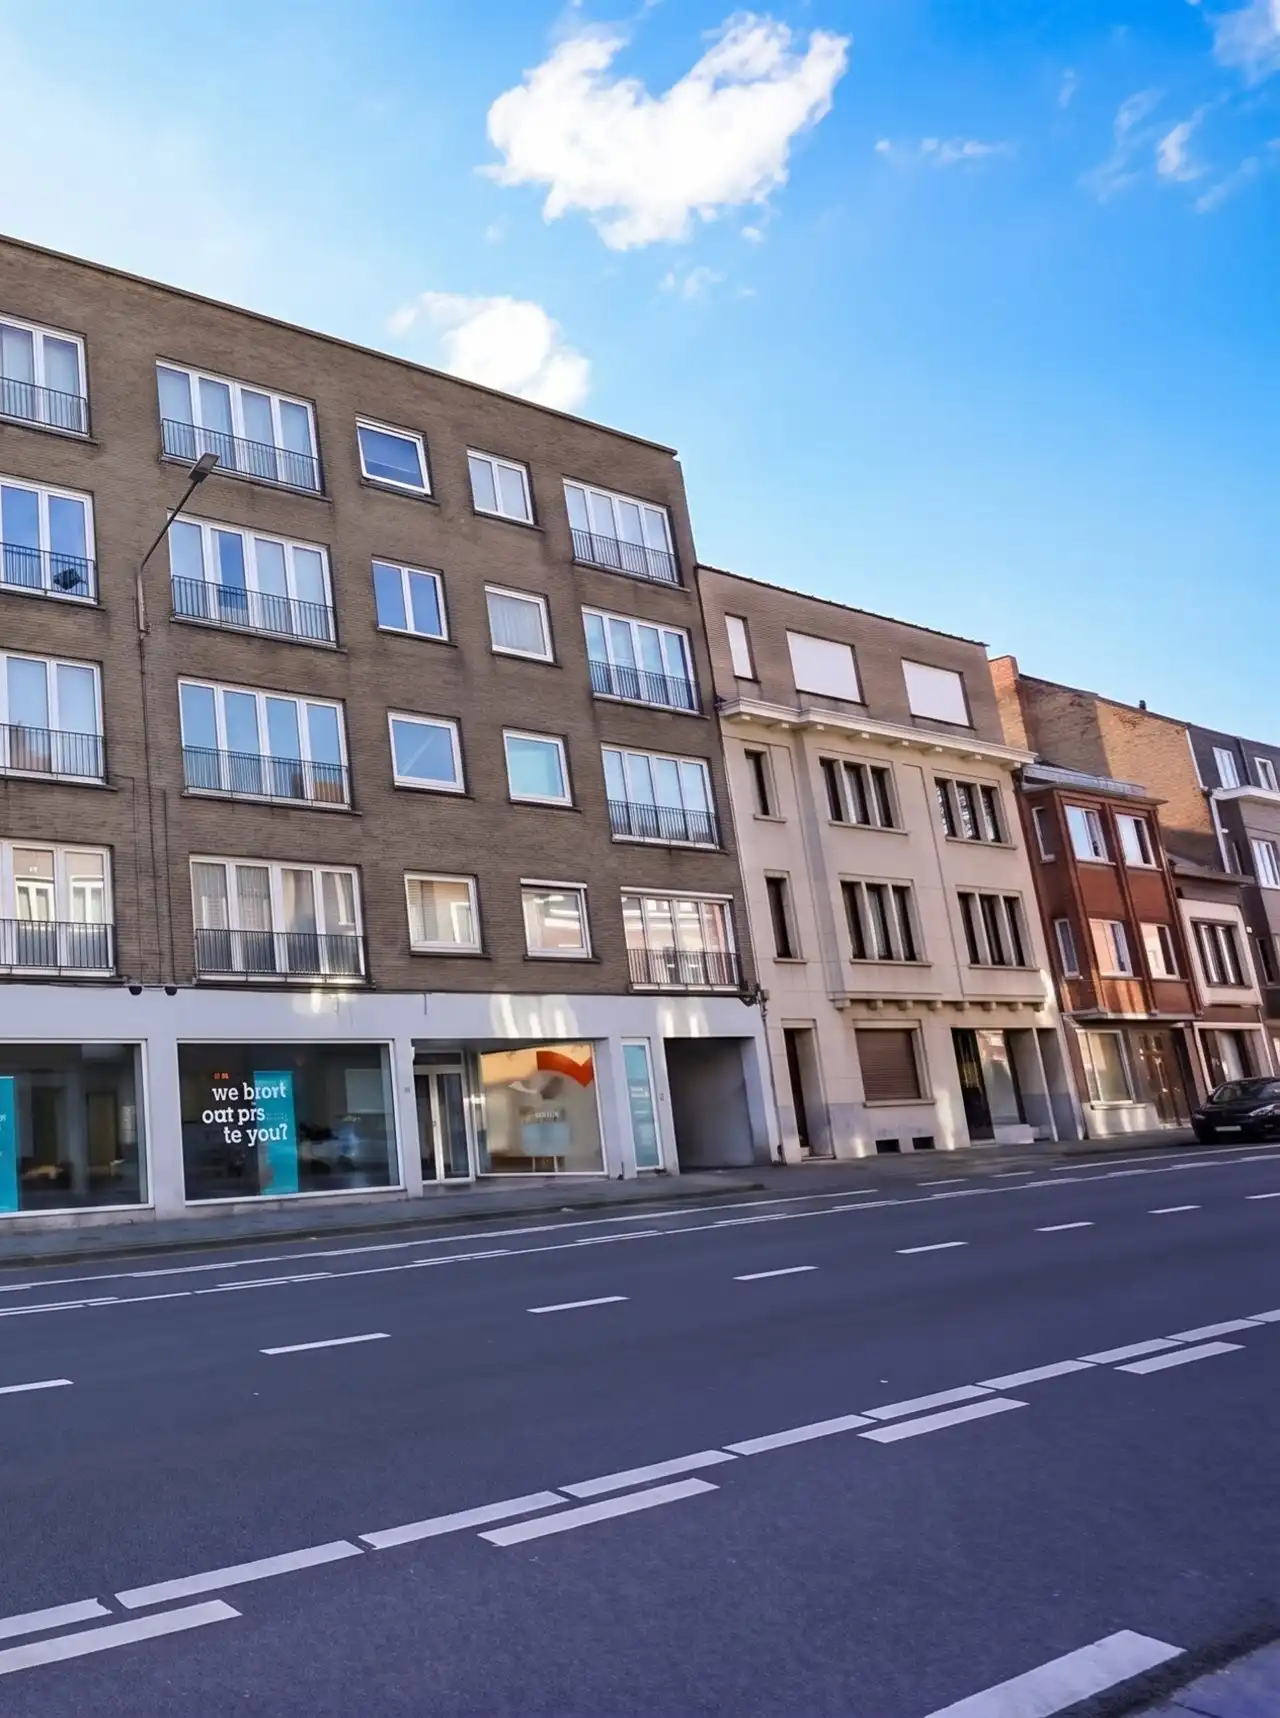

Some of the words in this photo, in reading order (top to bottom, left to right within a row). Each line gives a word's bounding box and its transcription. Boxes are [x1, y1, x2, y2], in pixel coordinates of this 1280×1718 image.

[211, 1086, 239, 1101] we
[223, 1126, 242, 1144] te
[246, 1123, 288, 1147] you?
